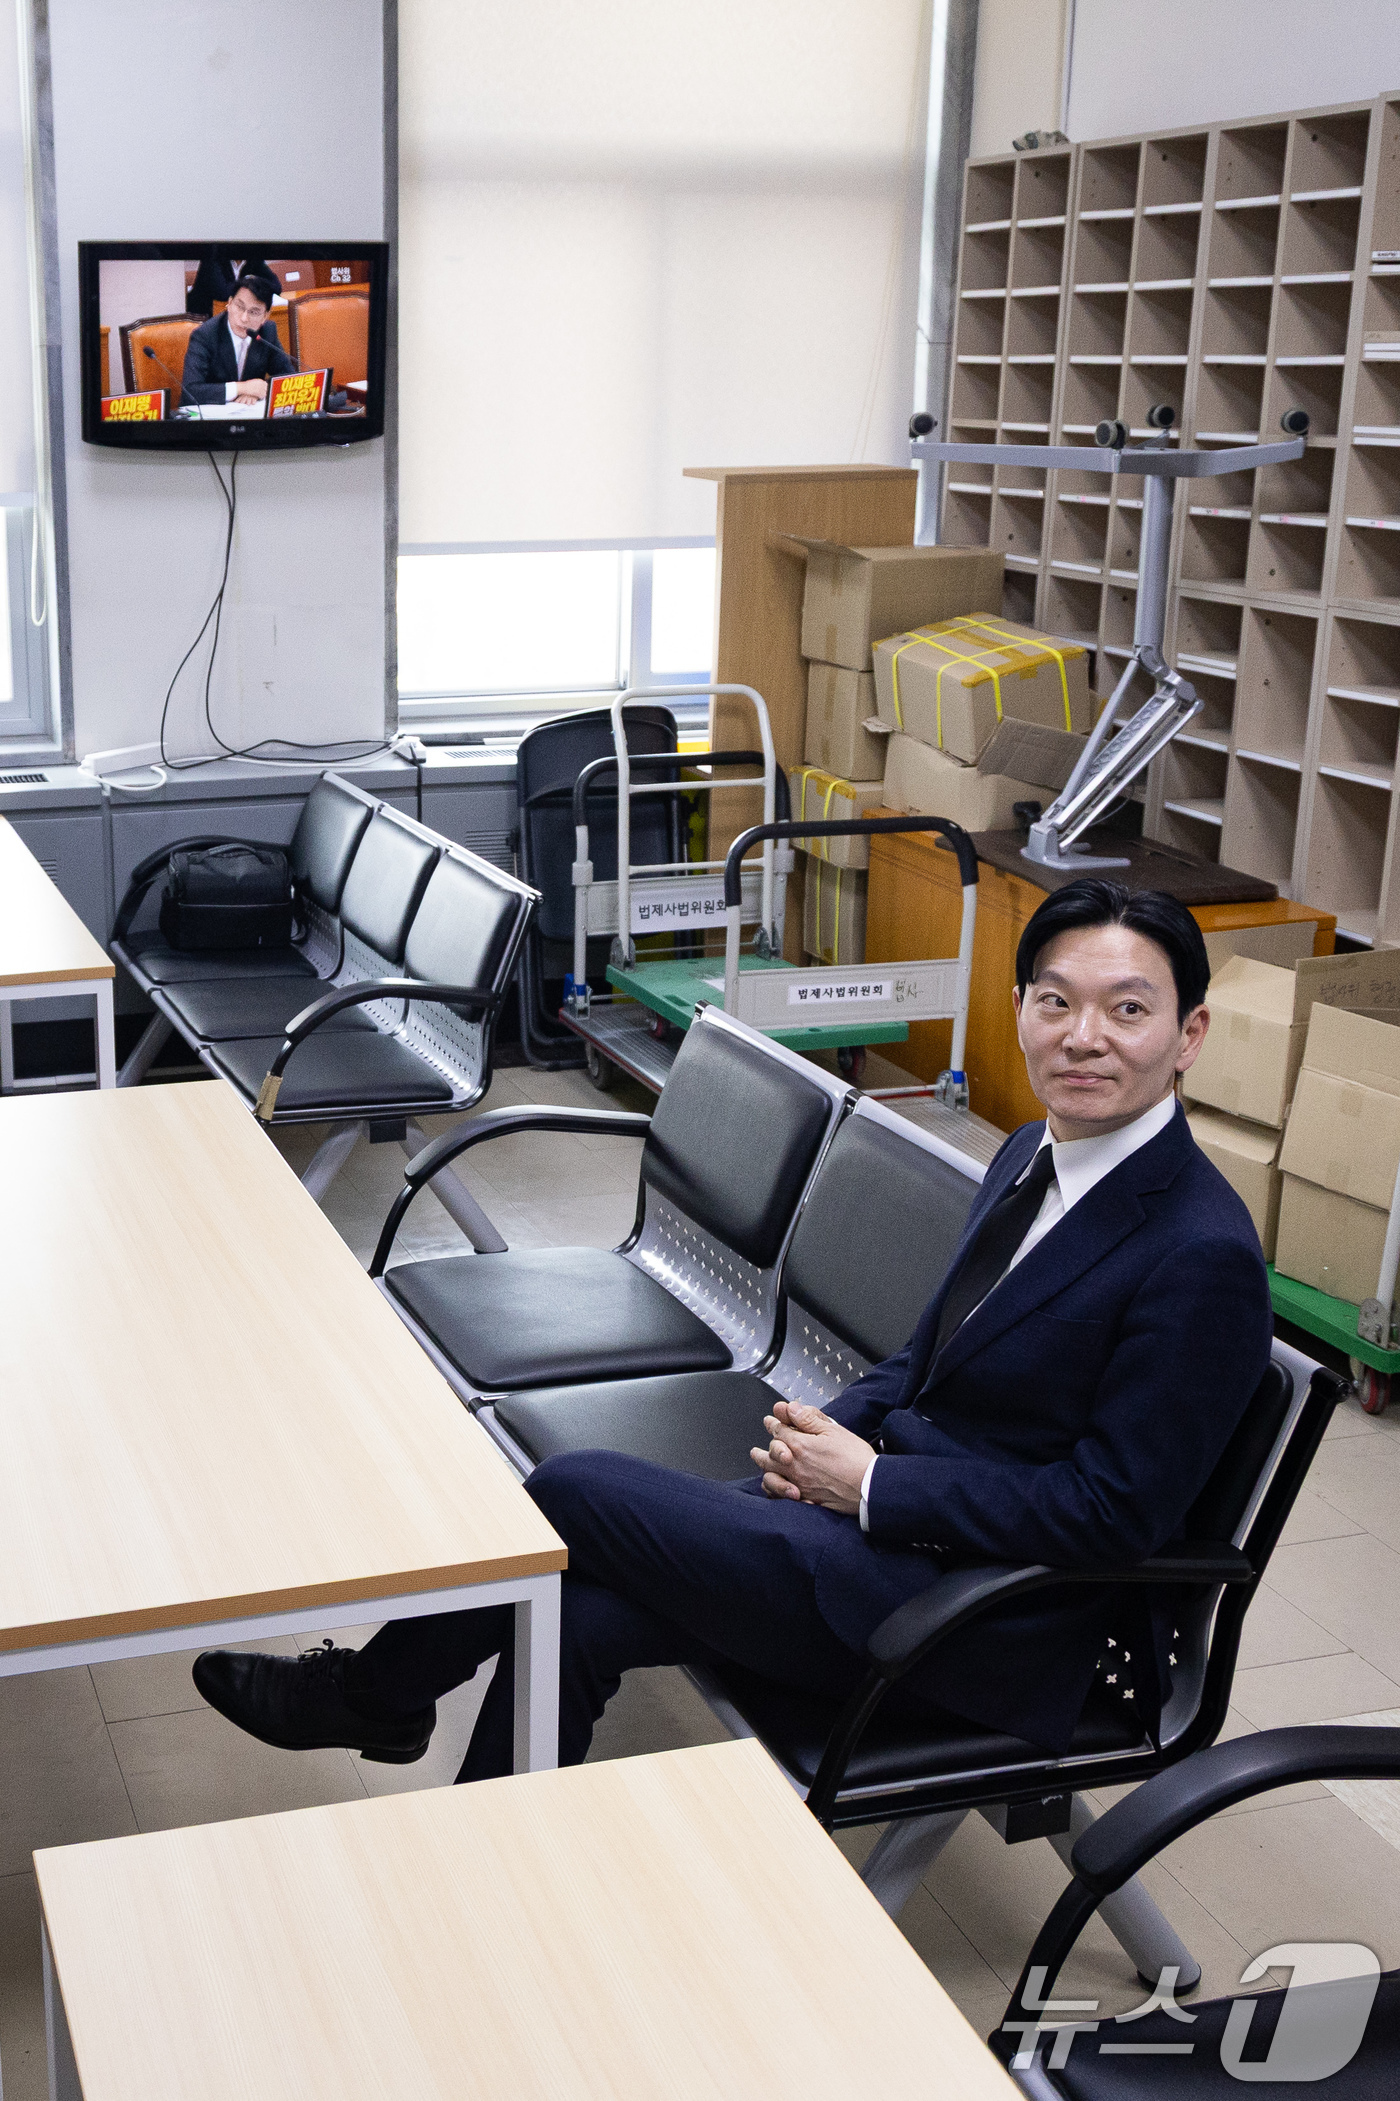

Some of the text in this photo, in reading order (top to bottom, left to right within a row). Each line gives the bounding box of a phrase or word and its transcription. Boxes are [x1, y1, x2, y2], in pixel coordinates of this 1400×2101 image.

[331, 275, 351, 283] Ch 32
[281, 373, 317, 392] 이재명
[110, 394, 151, 415] 이재명
[798, 984, 883, 1000] 법제사법위원회
